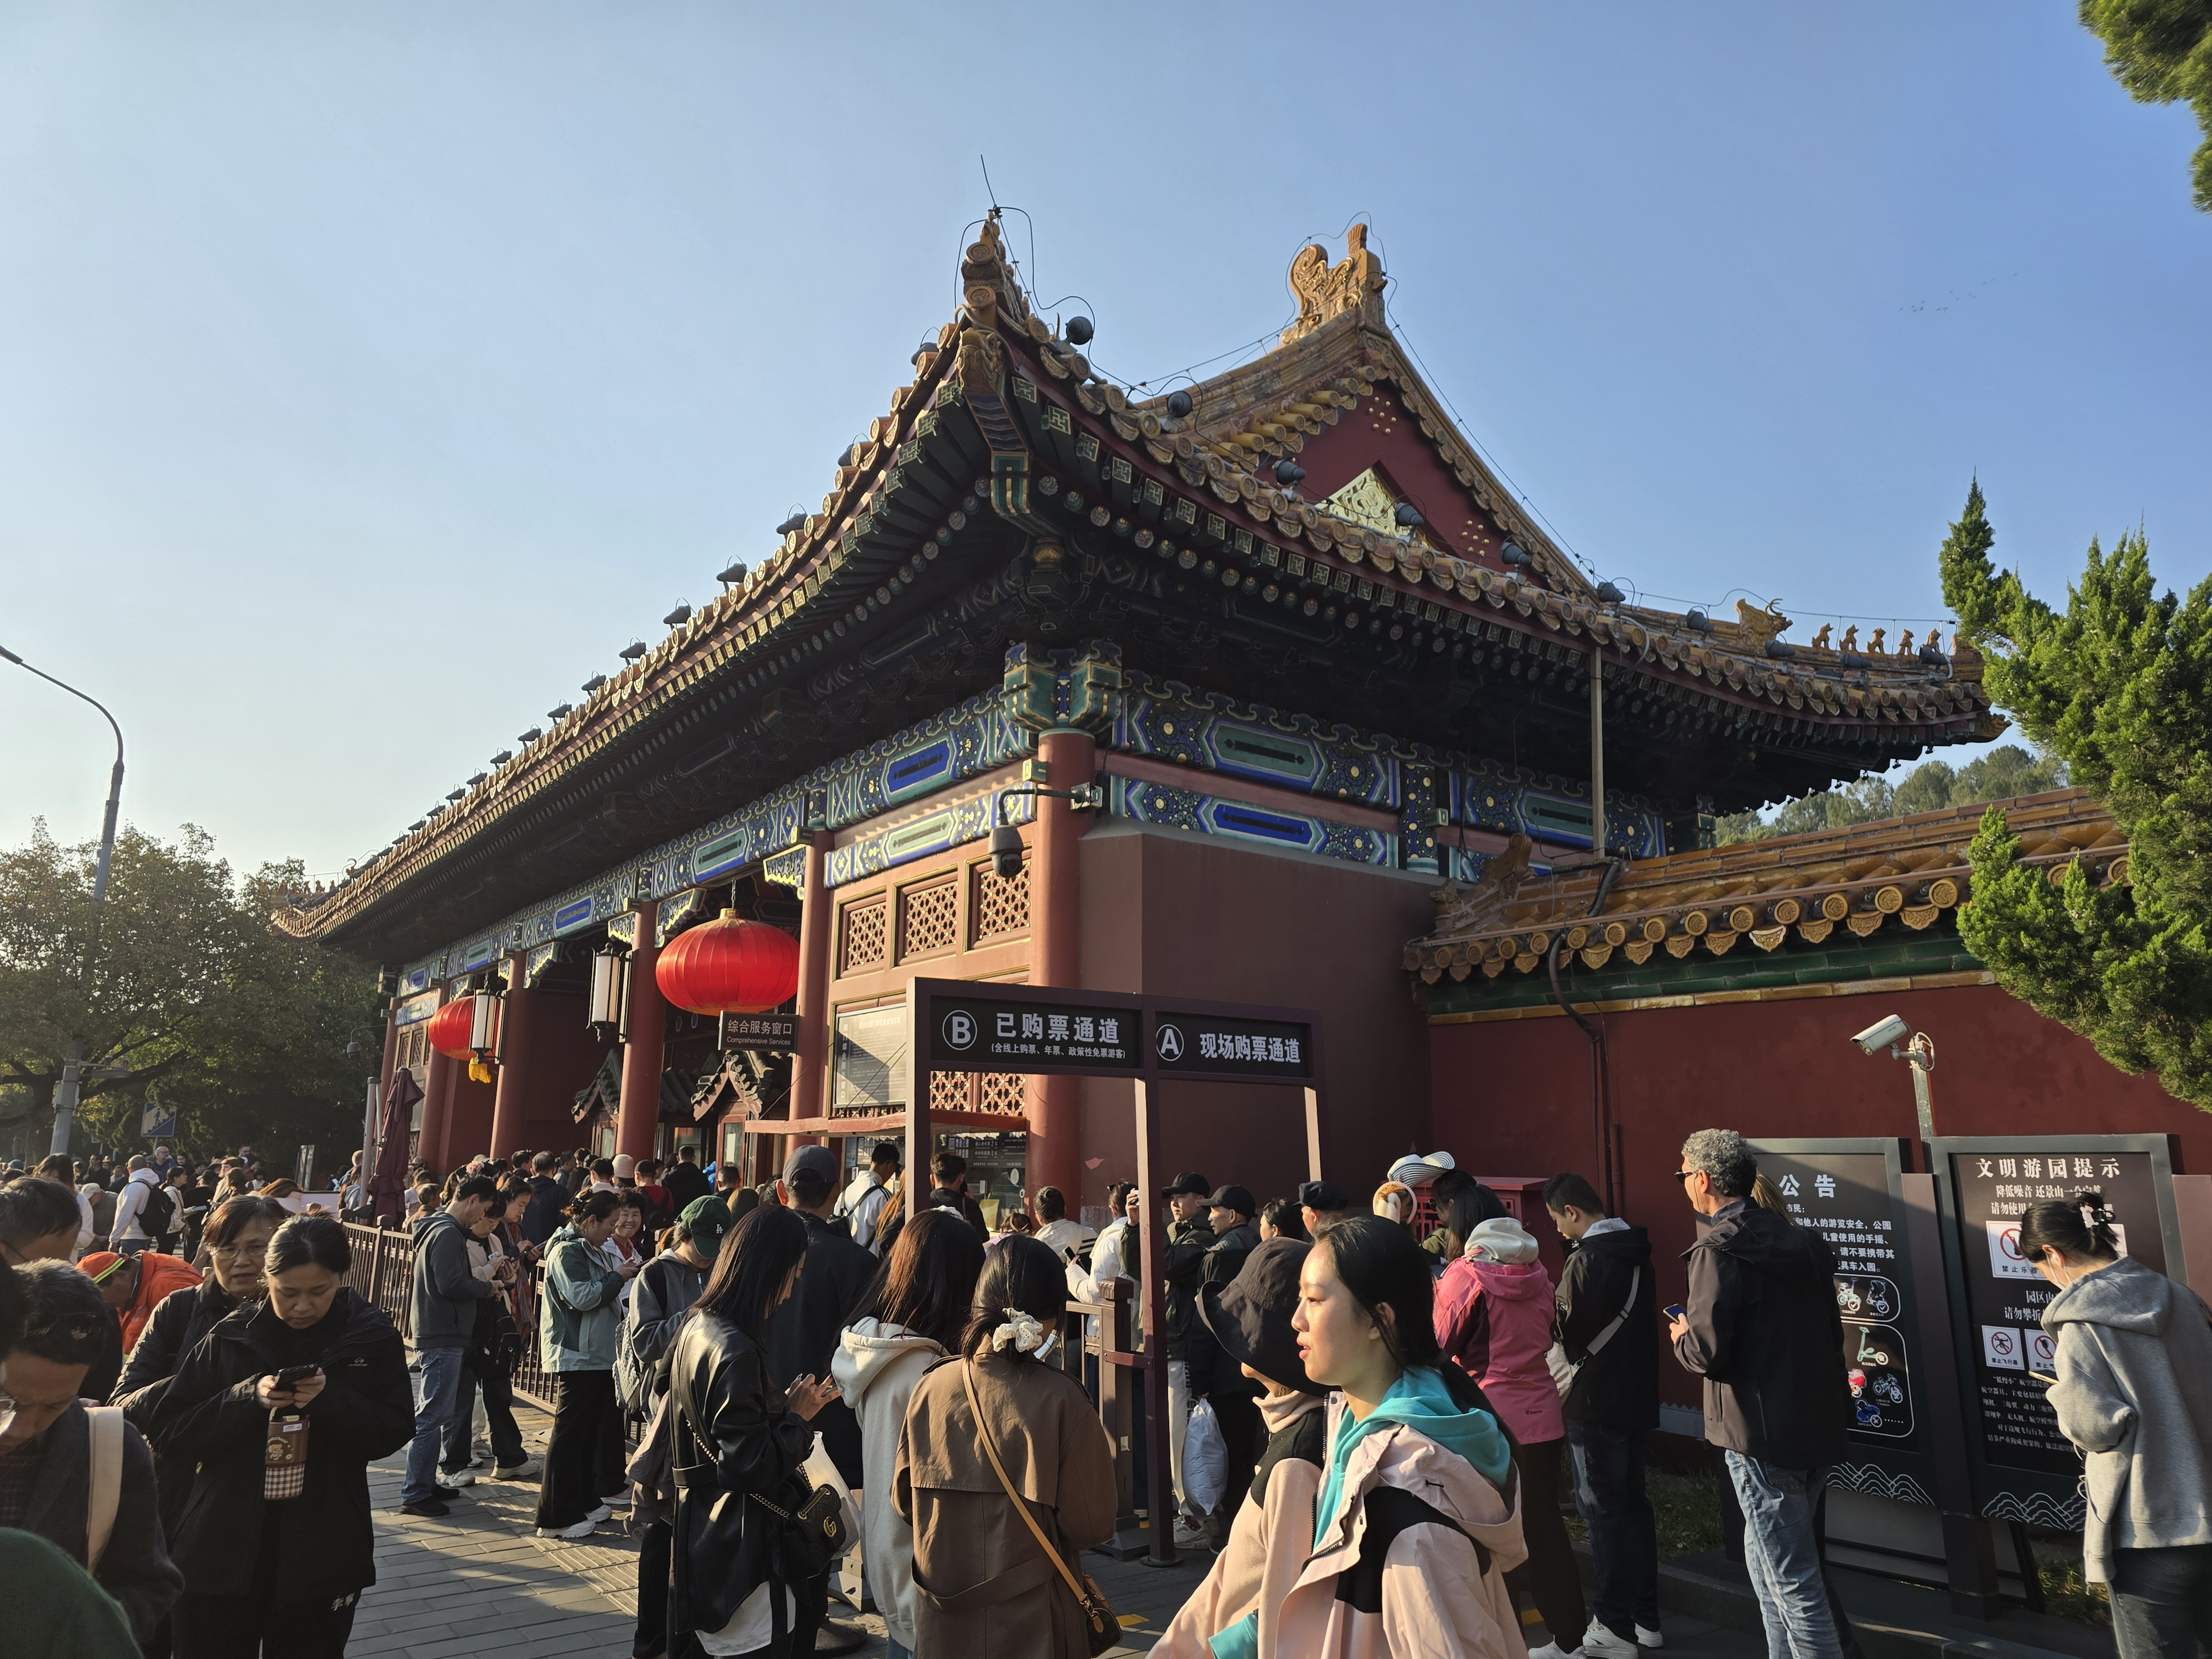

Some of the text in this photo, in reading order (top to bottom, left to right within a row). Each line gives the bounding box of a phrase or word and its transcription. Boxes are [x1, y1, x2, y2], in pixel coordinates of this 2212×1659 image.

[727, 1019, 792, 1035] 综合服务窗口
[952, 1016, 971, 1044] B
[996, 1012, 1119, 1044] 已购票通道
[727, 1036, 768, 1045] Comprehensive
[1160, 1028, 1180, 1055] A
[1199, 1032, 1301, 1063] 现场购票通道
[1975, 1157, 2120, 1179] 文明游园提示
[1778, 1173, 1836, 1198] 公告
[1995, 1184, 2033, 1198] 降低噪音
[1991, 1202, 2032, 1215] 请勿使用
[1793, 1217, 1892, 1230] 和他人的游览安全，公园
[2026, 1290, 2058, 1303] 园区内
[2004, 1306, 2046, 1322] 请勿攀折
